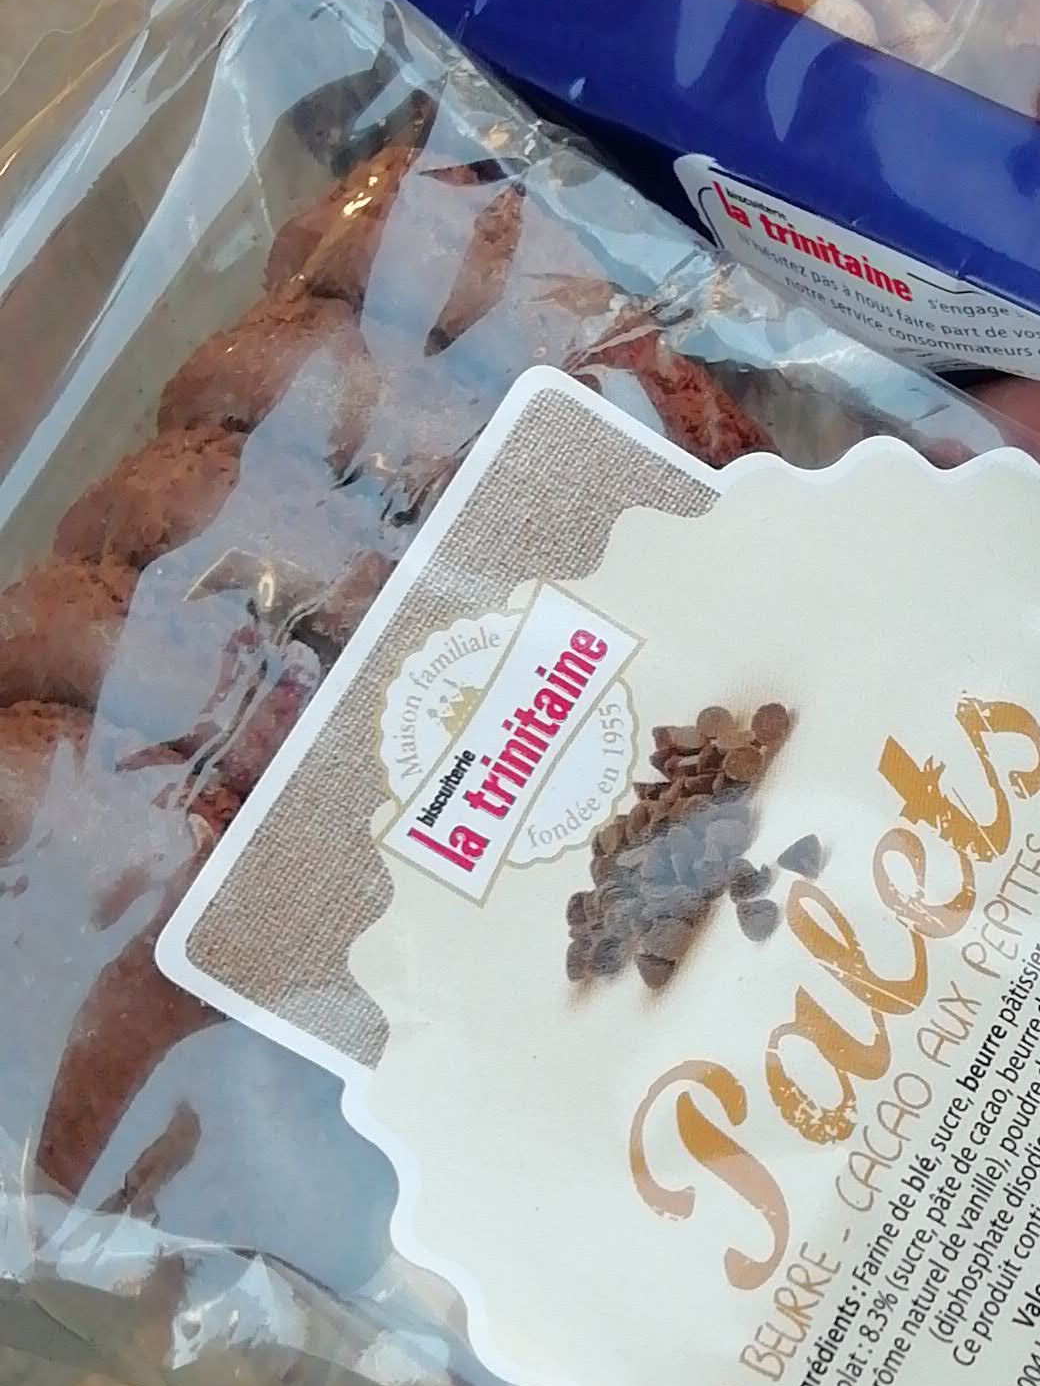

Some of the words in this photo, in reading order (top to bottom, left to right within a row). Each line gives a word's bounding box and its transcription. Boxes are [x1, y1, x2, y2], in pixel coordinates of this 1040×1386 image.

[759, 213, 912, 302] trinitaine
[887, 326, 1033, 357] consommateurs
[895, 309, 936, 332] faire
[940, 325, 980, 337] part
[927, 299, 1010, 318] s'engage
[405, 629, 503, 692] familiale
[401, 696, 422, 780] Maison
[404, 802, 491, 874] la
[459, 624, 612, 824] trinitaine
[526, 795, 602, 847] fondée
[598, 702, 625, 754] 1955
[415, 743, 478, 831] biscuiterie
[953, 1022, 1009, 1094] beurre
[928, 1095, 976, 1154] sucre,
[736, 1238, 845, 1383] BEURRE
[826, 1063, 941, 1217] CACAO
[908, 977, 987, 1069] AUX
[886, 1191, 918, 1223] de
[898, 1151, 944, 1194] blé,
[849, 1221, 901, 1288] Farine
[857, 1288, 900, 1344] 8.3%
[882, 1226, 940, 1293] (sucre,
[924, 1174, 963, 1229] pâte
[948, 1145, 979, 1176] de
[967, 1086, 1015, 1147] cacao,
[899, 1256, 951, 1338] naturel
[936, 1231, 968, 1263] de
[954, 1155, 1013, 1231] vanille),
[926, 1207, 1016, 1345] (diphosphate
[951, 1336, 983, 1367] Ce
[969, 1256, 1024, 1343] produit
